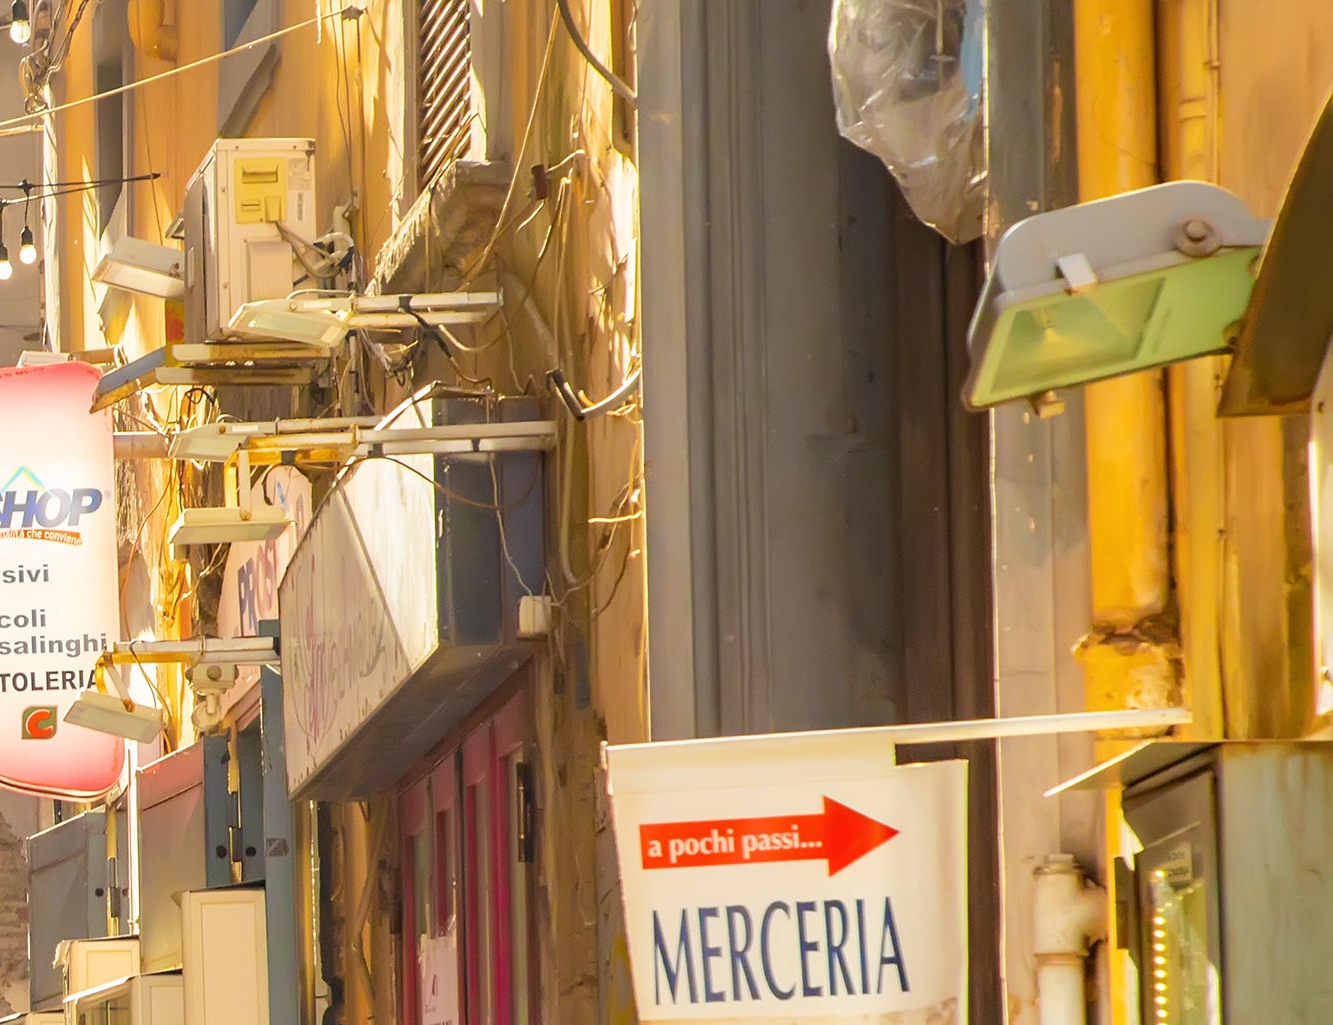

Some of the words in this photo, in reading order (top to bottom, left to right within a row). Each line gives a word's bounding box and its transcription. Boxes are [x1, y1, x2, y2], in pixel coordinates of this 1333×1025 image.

[26, 529, 43, 539] che
[648, 839, 662, 858] a
[669, 829, 734, 863] pochi
[742, 824, 822, 860] passi...
[653, 896, 911, 1005] MERCERIA
